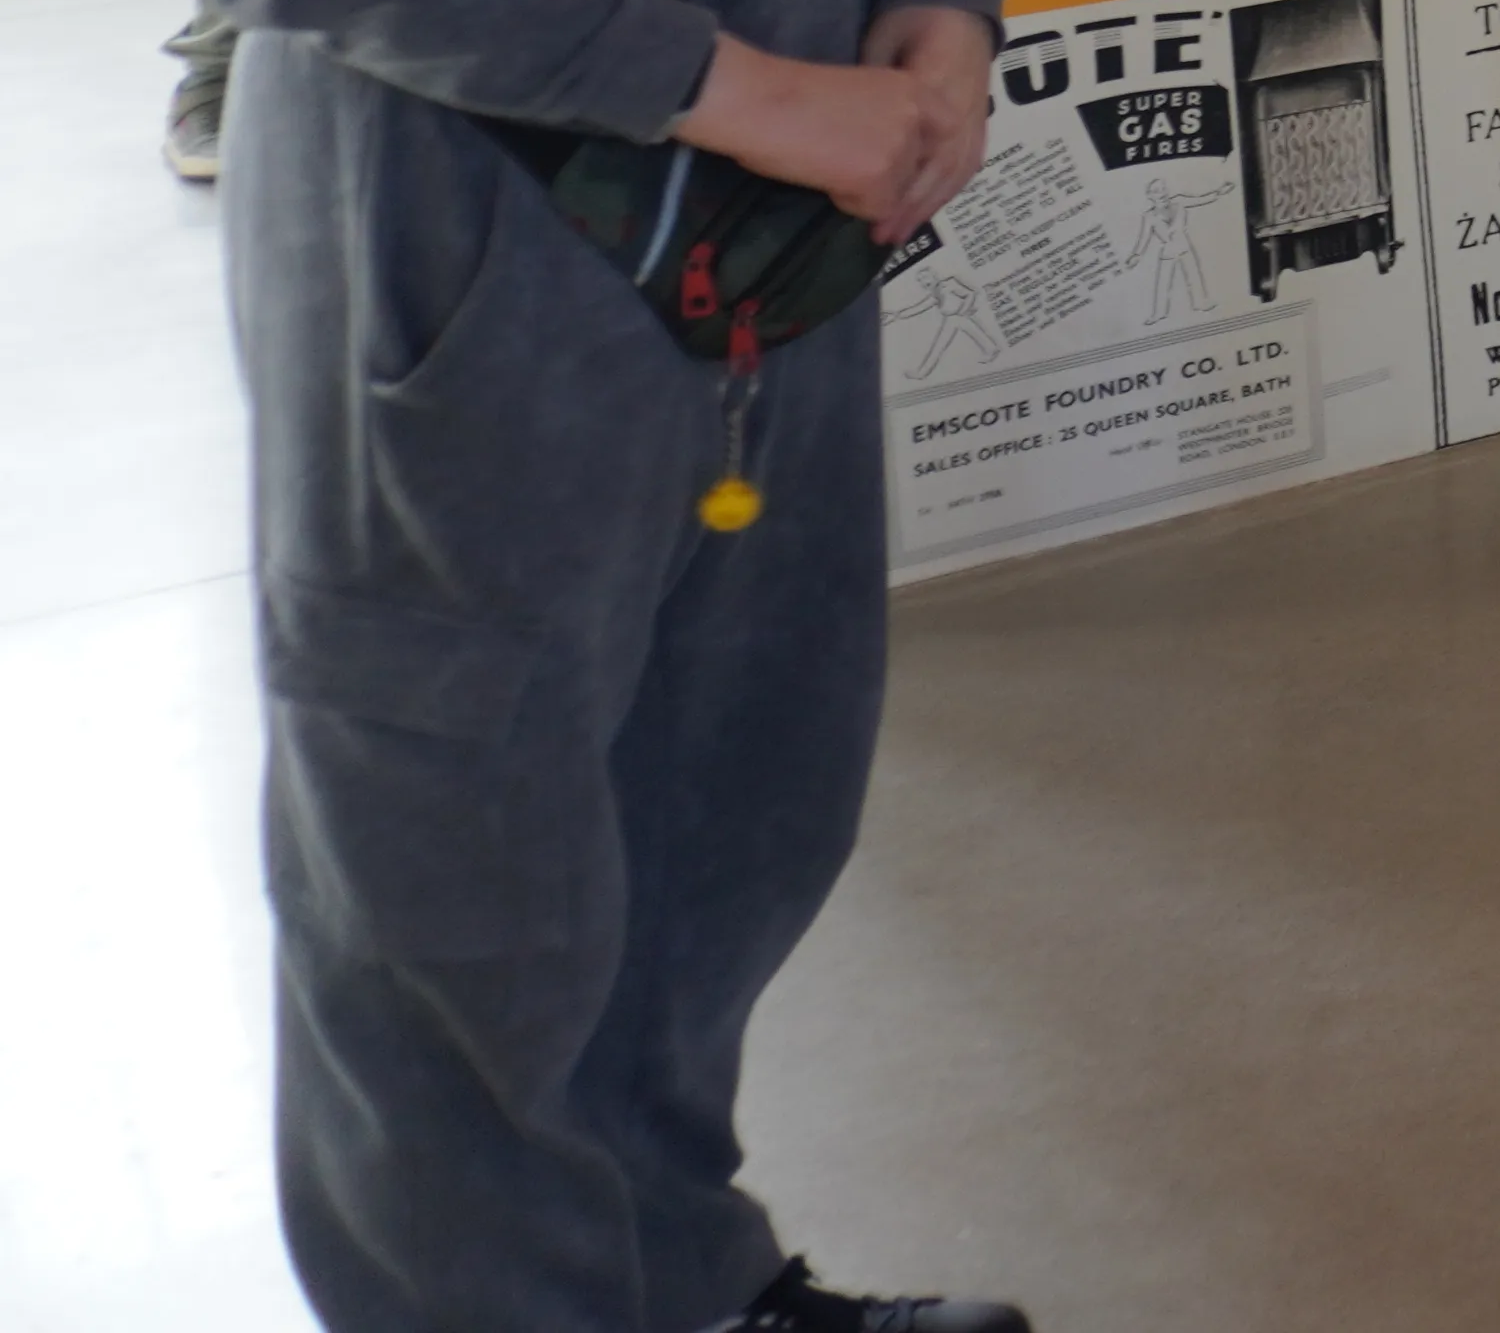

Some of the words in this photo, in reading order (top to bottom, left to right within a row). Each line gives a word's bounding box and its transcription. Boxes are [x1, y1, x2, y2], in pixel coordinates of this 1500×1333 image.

[1117, 90, 1202, 115] SUPER
[1118, 114, 1202, 144] GAS
[1125, 137, 1203, 162] FIRES
[911, 401, 1031, 443] EMSCOTE
[1045, 368, 1167, 412] FOUNDRY
[1181, 355, 1223, 379] CO.
[1236, 341, 1290, 366] LTD.
[913, 448, 971, 477] SALES
[1059, 424, 1078, 443] 25
[1084, 410, 1149, 437] QUEEN
[1156, 389, 1235, 420] SQUARE,
[1241, 375, 1291, 398] BATH
